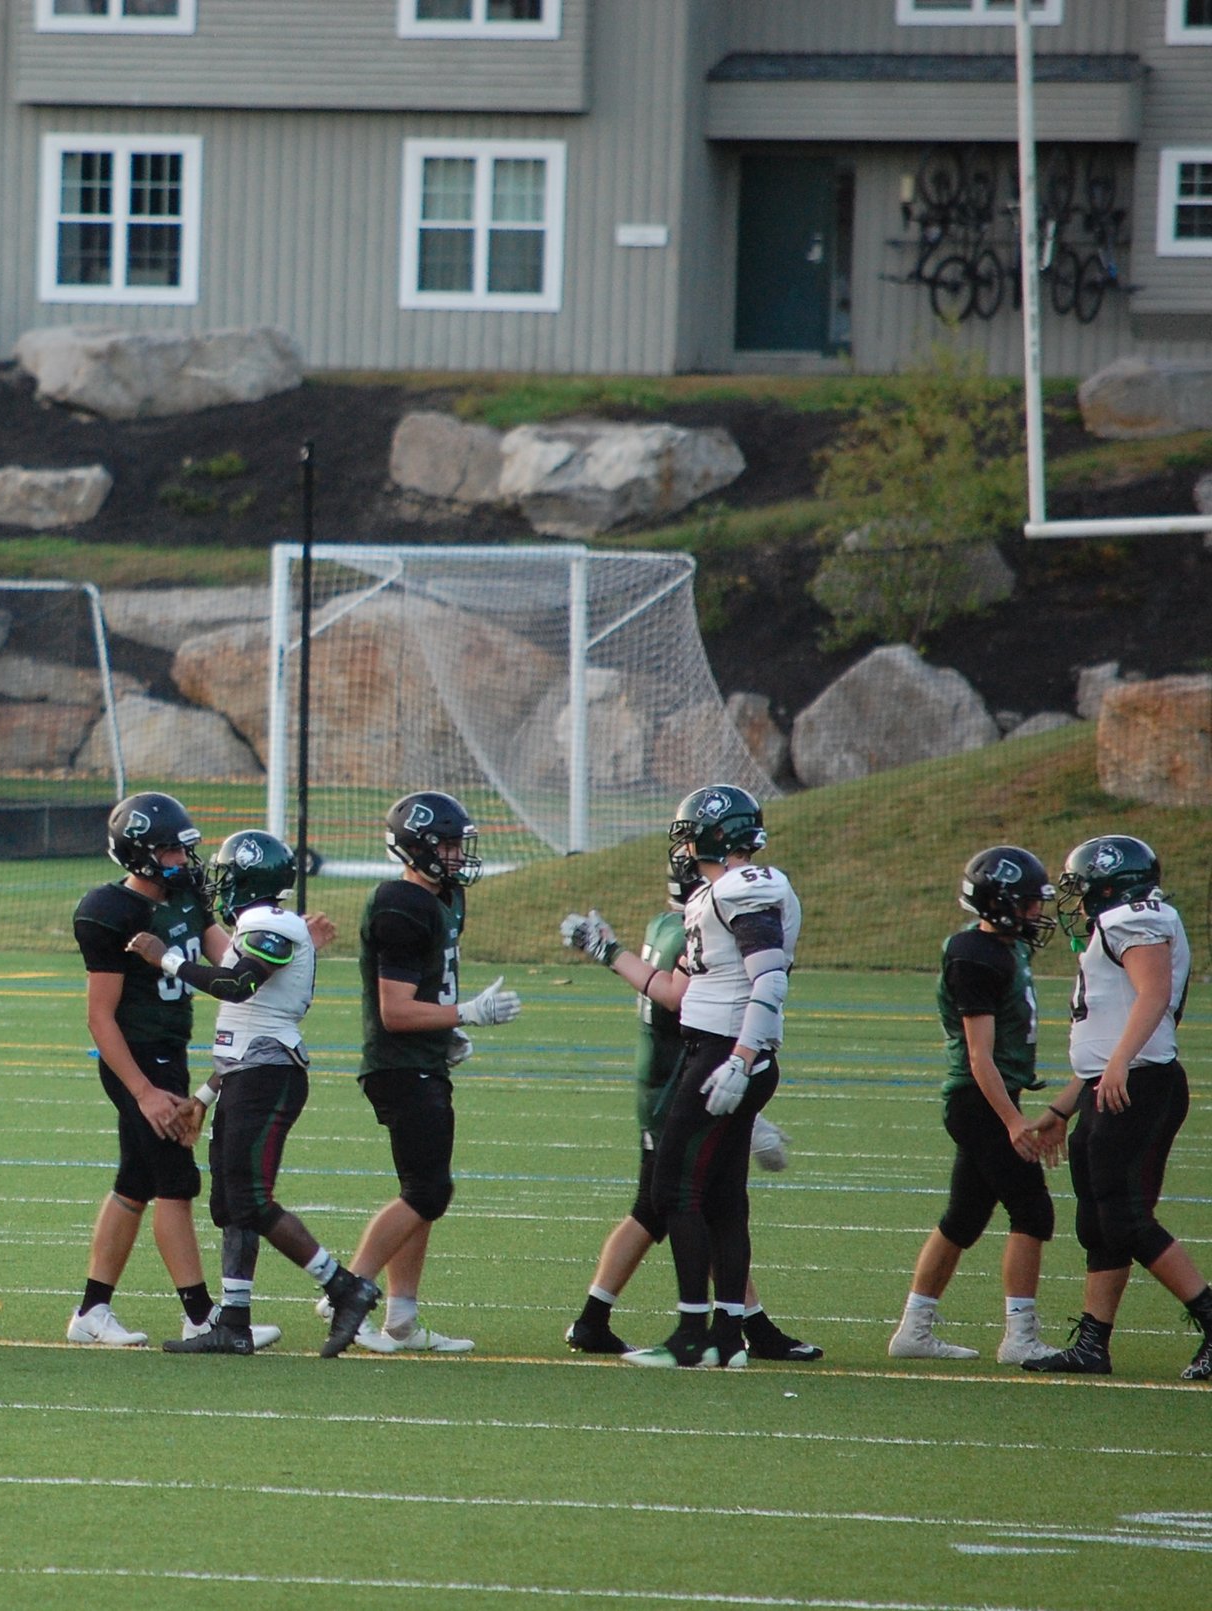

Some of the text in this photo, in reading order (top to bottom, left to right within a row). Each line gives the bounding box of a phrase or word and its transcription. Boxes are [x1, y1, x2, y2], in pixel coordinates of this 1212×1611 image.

[123, 810, 151, 838] P
[404, 804, 435, 832] P
[987, 858, 1023, 886] P
[439, 944, 461, 1006] 5
